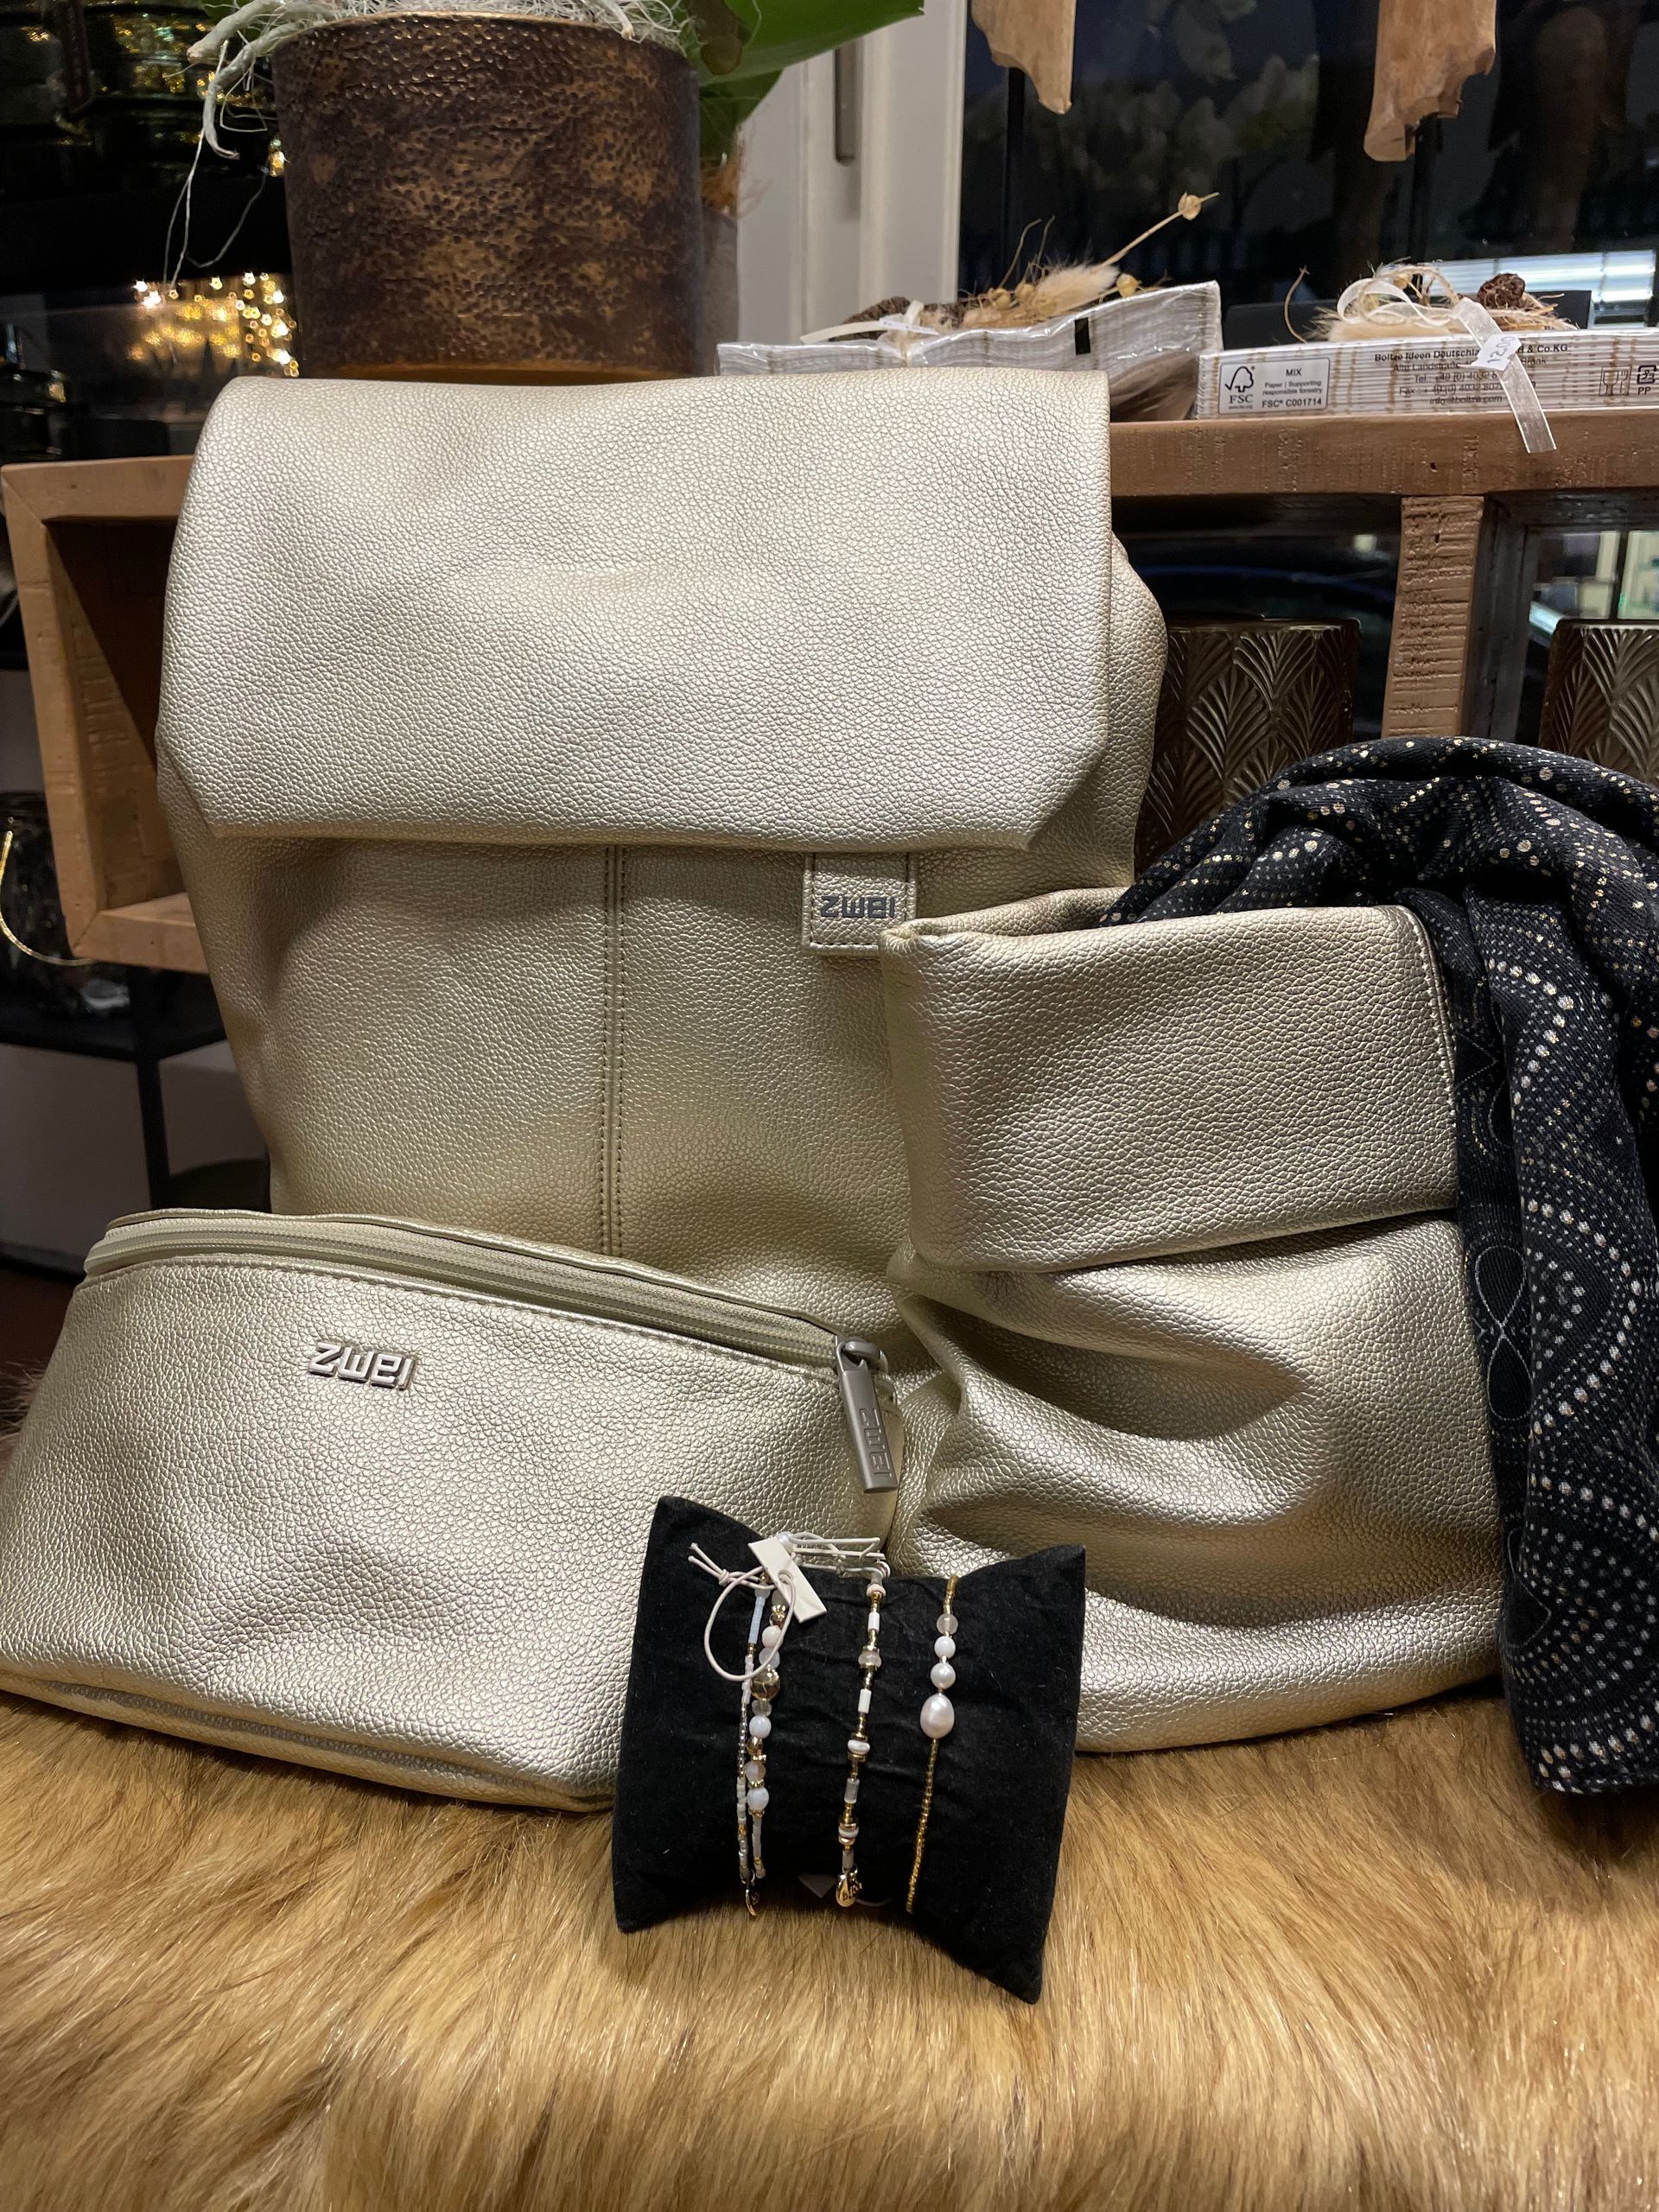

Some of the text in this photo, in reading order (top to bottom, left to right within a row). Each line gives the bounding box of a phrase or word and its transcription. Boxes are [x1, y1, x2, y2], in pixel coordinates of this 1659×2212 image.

[1405, 351, 1431, 360] Ideen
[1286, 368, 1302, 377] MIX
[1637, 386, 1651, 395] PP
[1229, 394, 1253, 404] FSC
[1286, 397, 1322, 407] C001714
